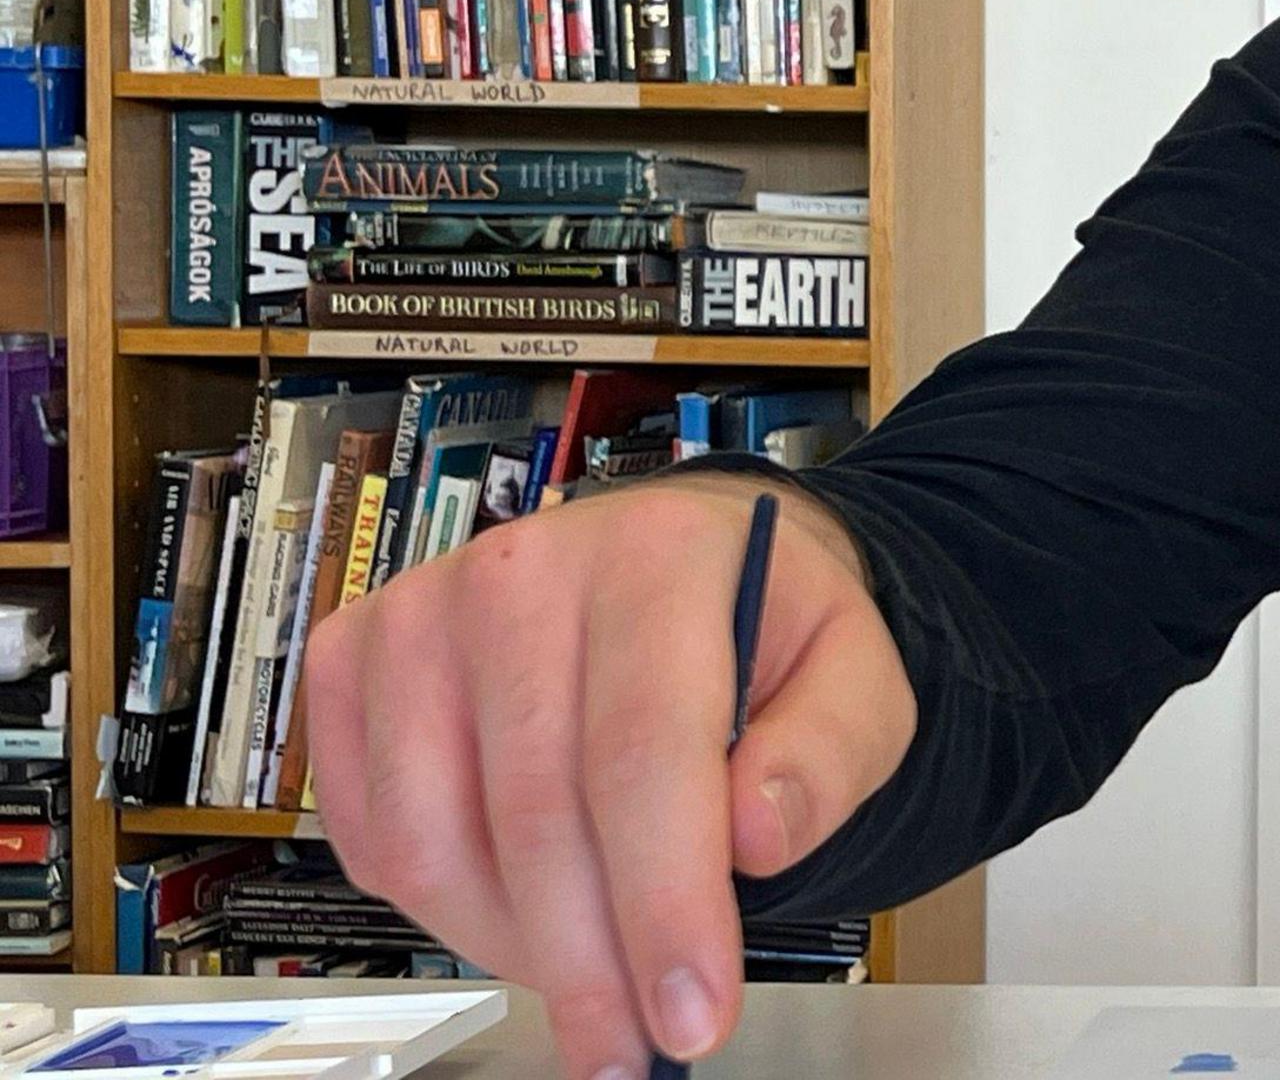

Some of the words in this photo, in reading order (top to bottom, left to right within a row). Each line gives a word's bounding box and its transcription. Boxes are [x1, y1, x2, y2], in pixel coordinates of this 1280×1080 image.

[351, 83, 453, 104] NATURAL
[470, 84, 546, 104] WORLD
[251, 136, 318, 168] THE
[318, 151, 500, 200] ANIMALS
[188, 145, 217, 304] APRÓSÁGOK
[248, 169, 316, 295] SEA
[356, 260, 390, 275] THE
[393, 260, 426, 276] LIFE
[427, 262, 446, 276] OF
[450, 260, 511, 278] BIRDS
[703, 258, 735, 327] THE
[735, 257, 866, 327] EARTH
[331, 293, 398, 315] BOOK
[402, 294, 436, 316] OF
[440, 295, 535, 320] BRITISH
[541, 297, 616, 321] BIRDS
[375, 335, 476, 356] NATURAL
[500, 335, 579, 356] WORLD
[388, 393, 422, 479] CANADA
[323, 456, 358, 558] RAILWAYS
[271, 533, 288, 581] RACING
[345, 494, 381, 604] TRAINS
[266, 582, 283, 618] CARS
[251, 657, 273, 751] MOTORCYCLES
